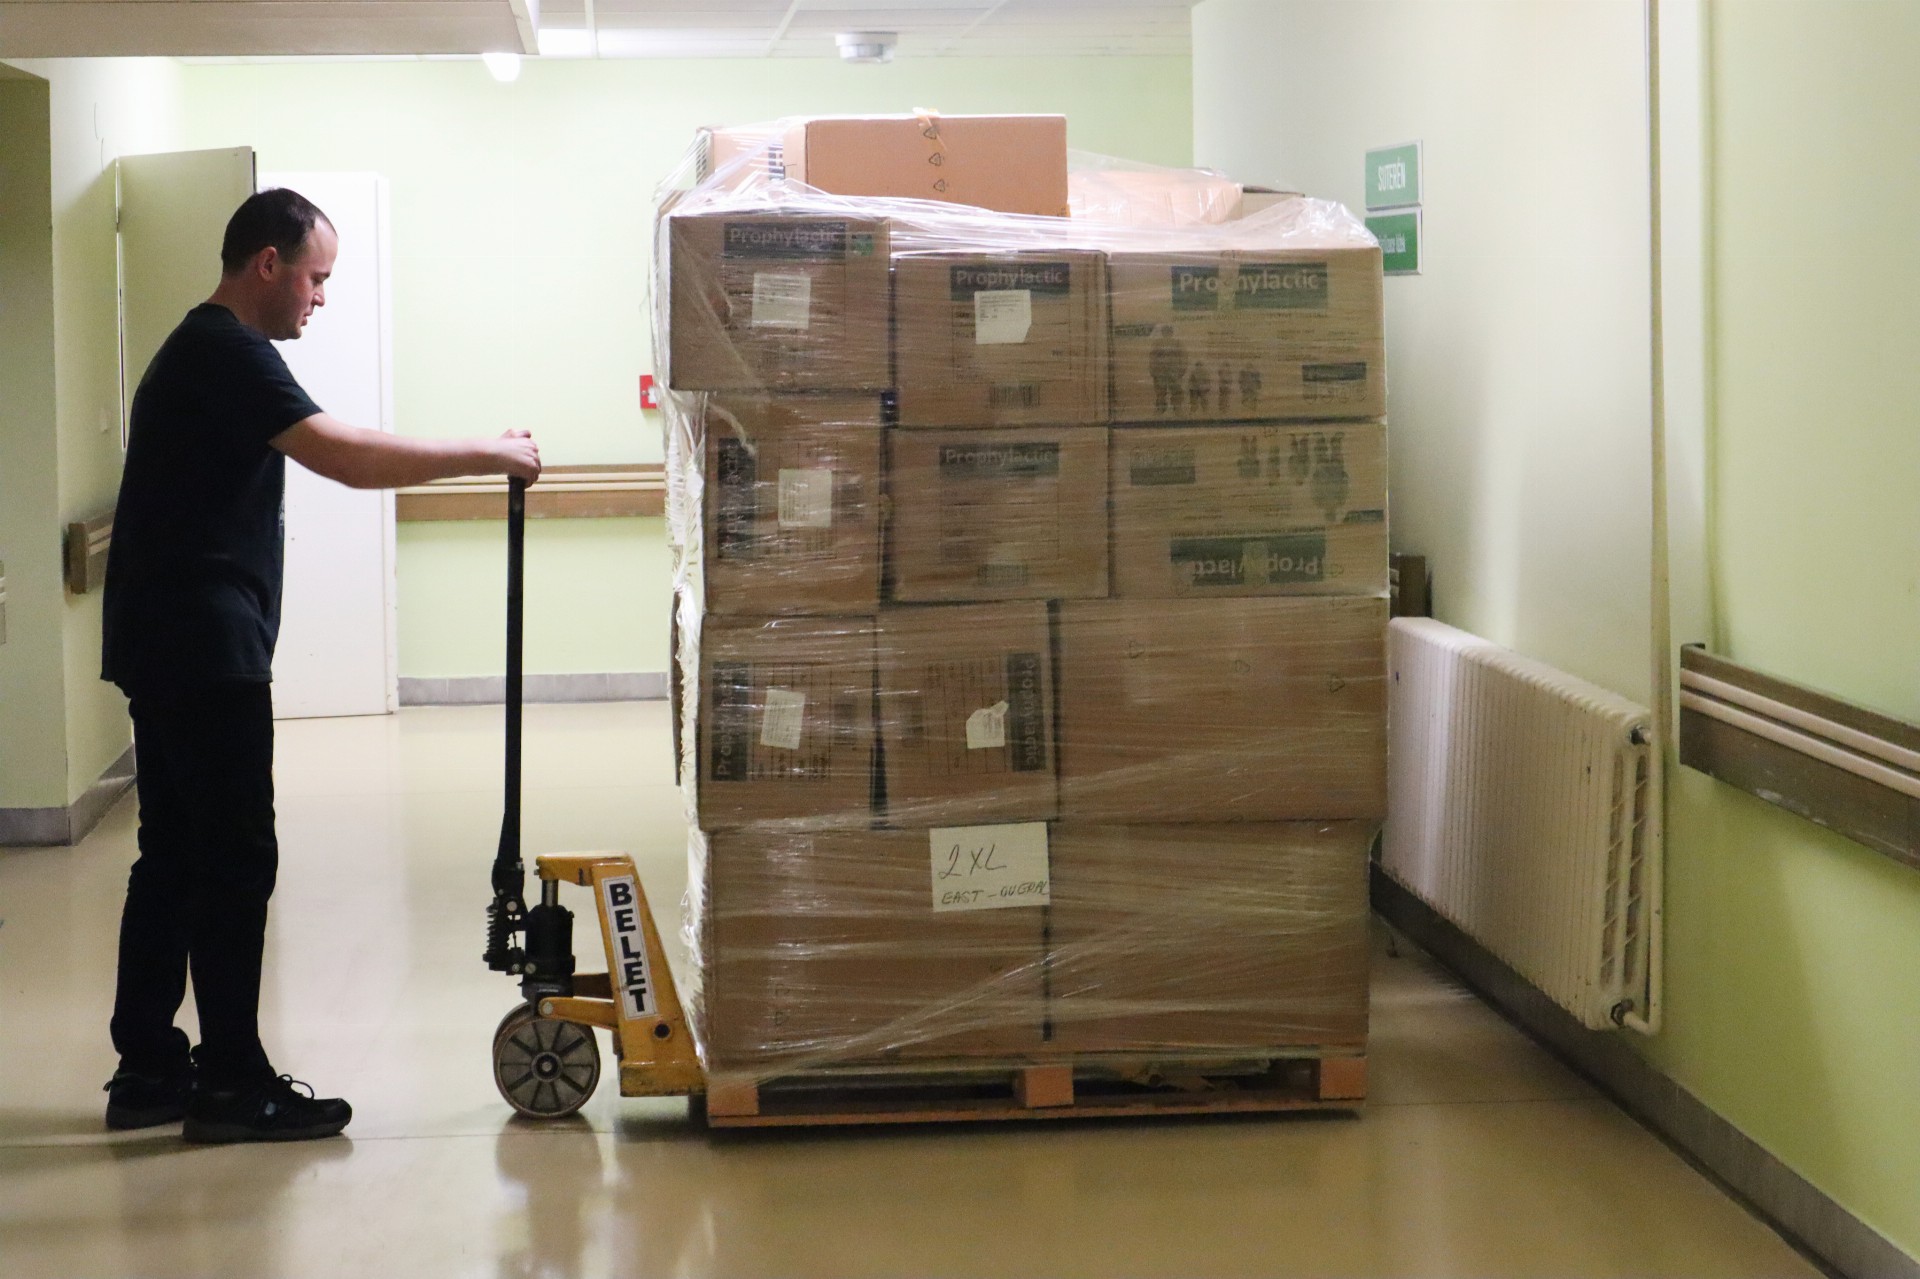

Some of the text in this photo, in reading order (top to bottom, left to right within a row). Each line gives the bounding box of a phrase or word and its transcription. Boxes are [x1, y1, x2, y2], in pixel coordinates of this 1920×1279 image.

[1378, 157, 1406, 191] SUTERÉN
[956, 268, 1064, 289] Prophylactic
[609, 883, 647, 1012] BELET
